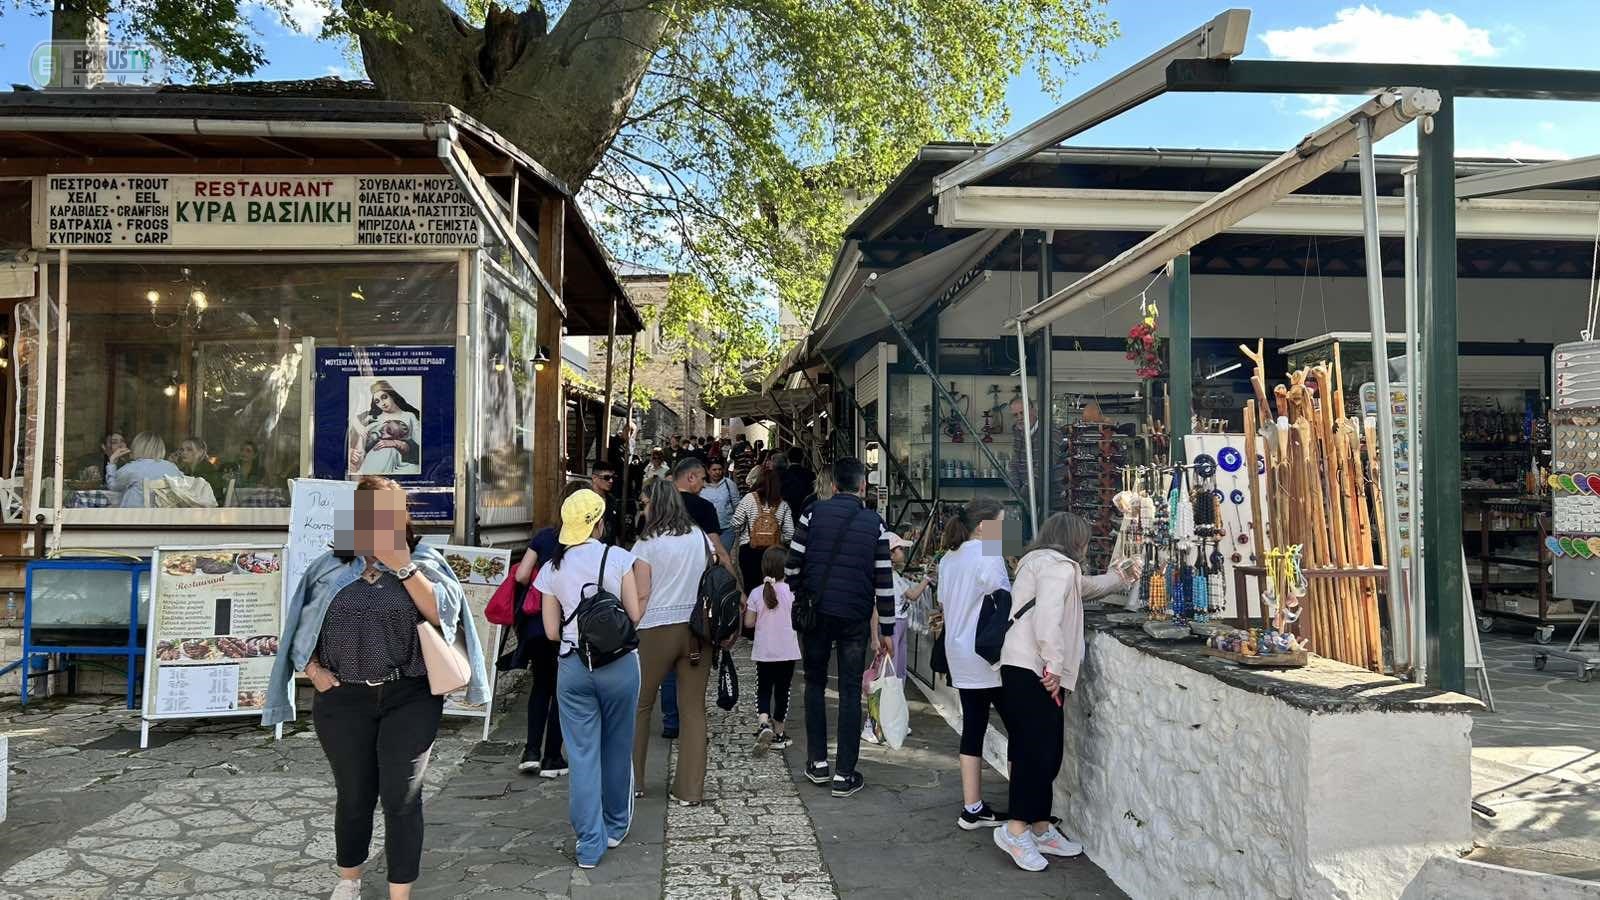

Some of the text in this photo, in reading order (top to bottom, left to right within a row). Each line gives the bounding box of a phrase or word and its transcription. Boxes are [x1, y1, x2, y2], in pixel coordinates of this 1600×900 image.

[50, 178, 169, 190] ΠΕΣΤΡΟΦΑ TROUT
[194, 180, 334, 197] RESTAURANT
[358, 178, 417, 191] ΣΟΥΒΛΑΚΙ
[67, 191, 160, 203] ΧΕΛΙ EEL
[358, 191, 401, 204] ΦΙΛΕΤΟ
[49, 204, 169, 217] ΚΑΡΑΒΙΔΕΣ CRAWFISH
[176, 200, 352, 223] ΚΥΡΑ ΒΑΣΙΛΙΚΗ
[358, 205, 412, 217] ΠΑΙΔΑΚΙΑ
[49, 218, 169, 230] ΒΑΤΡΑΧΙΑ FROGS
[358, 219, 478, 231] ΜΠΡΙΖΟΛΑ ΓΕΜΙΣΤΑ
[49, 232, 169, 244] ΚΥΠΡΙΝΟΣ CARP
[358, 232, 478, 244] ΜΠΙΦΤΕΚΙ ΚΟΤΟΠΟΥΛΟ
[175, 575, 225, 591] Restaurant
